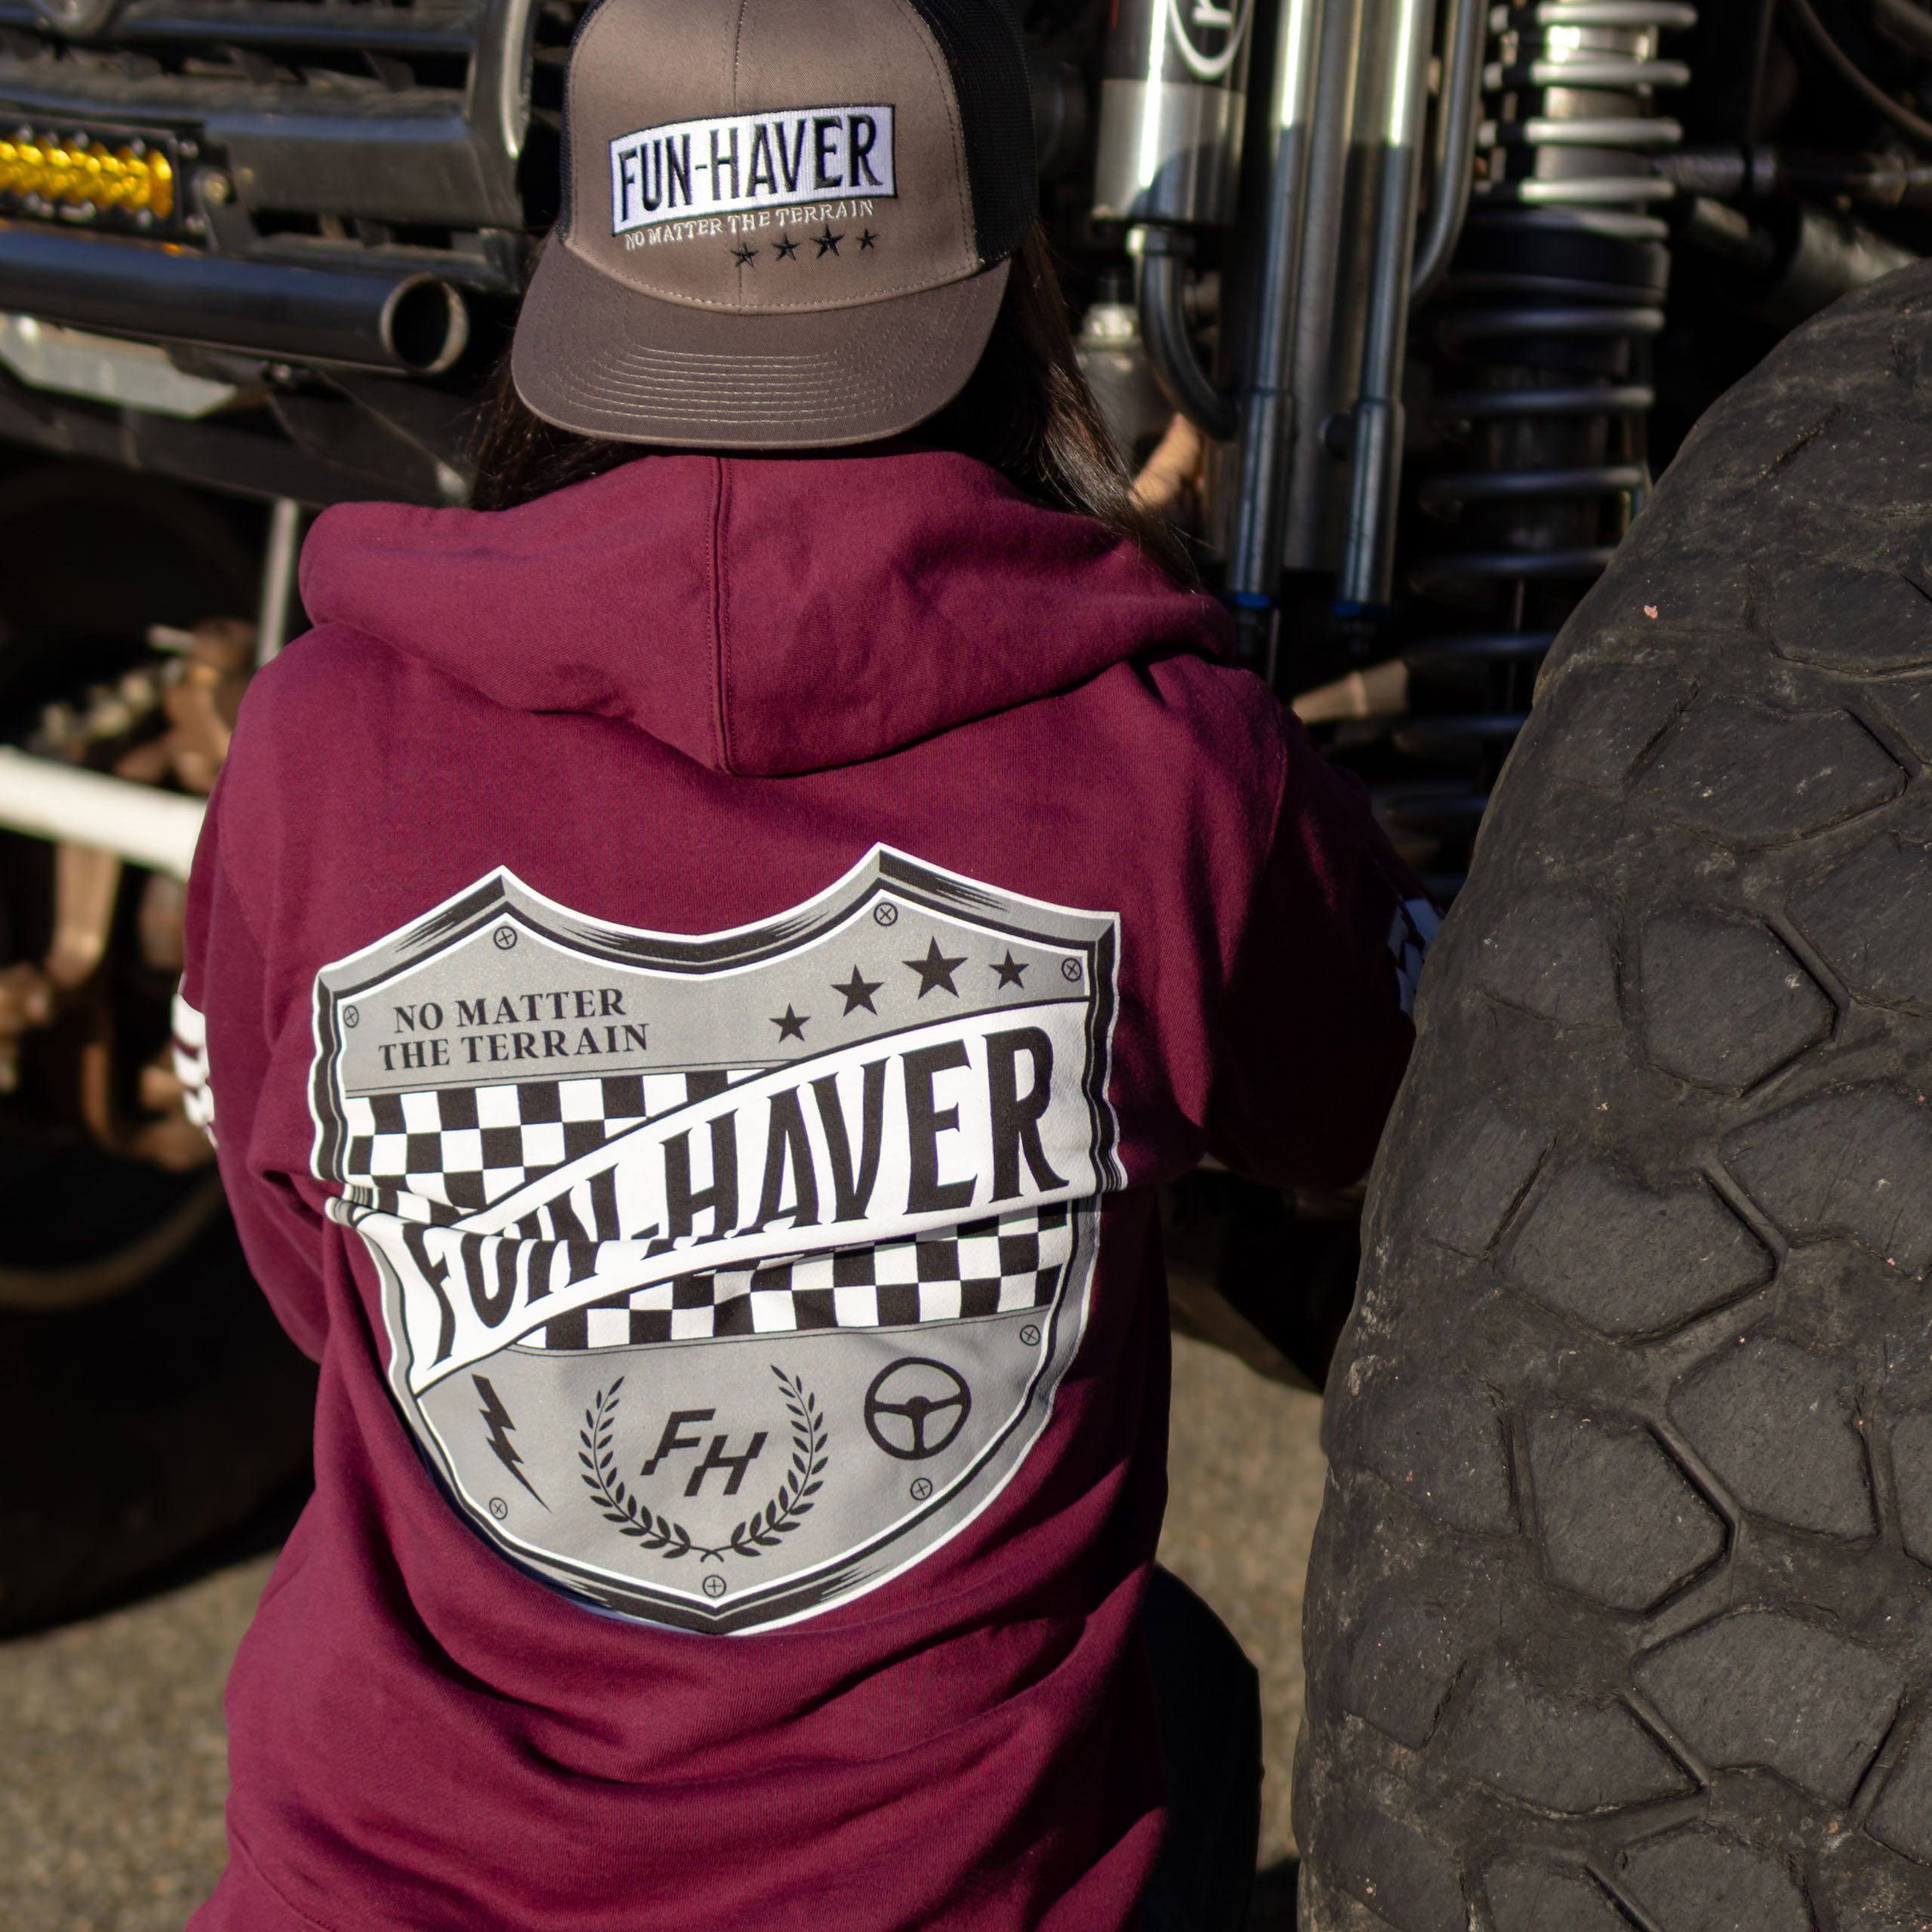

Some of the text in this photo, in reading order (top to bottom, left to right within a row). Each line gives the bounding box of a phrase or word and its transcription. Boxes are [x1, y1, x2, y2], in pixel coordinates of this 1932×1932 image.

[617, 113, 884, 222] FUN-HAVER
[625, 199, 874, 251] NO MATTER THE TERRAIN
[392, 987, 627, 1033] NO MATTER
[378, 1023, 651, 1072] THE TERRAIN
